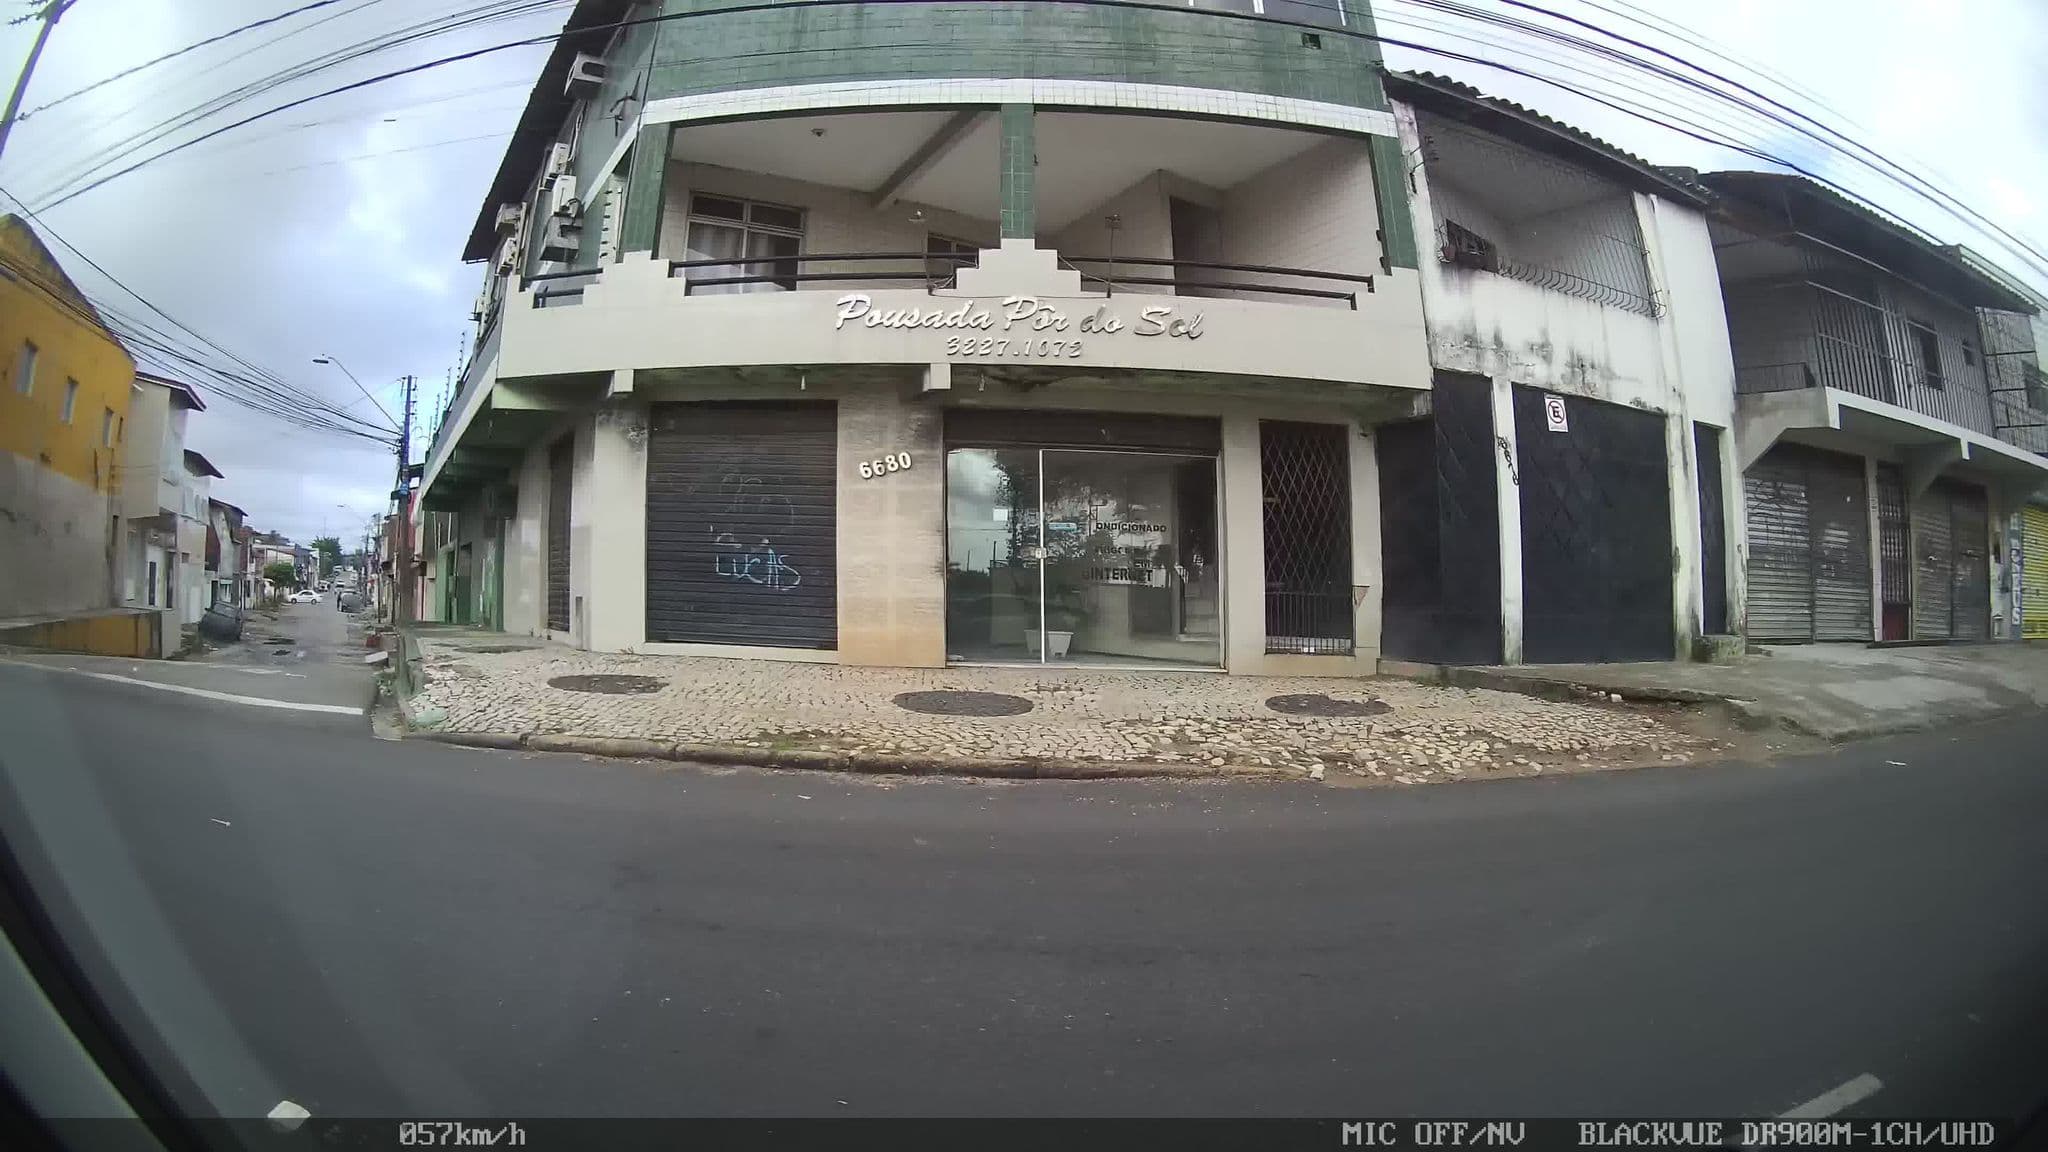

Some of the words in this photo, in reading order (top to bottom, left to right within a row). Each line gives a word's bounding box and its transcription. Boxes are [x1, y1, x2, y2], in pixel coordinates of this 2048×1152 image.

[834, 294, 994, 331] Pousada
[1080, 304, 1124, 333] do
[1134, 305, 1204, 340] Sol
[946, 336, 1082, 358] 3227.1072
[859, 452, 912, 479] 6680
[715, 548, 801, 591] LUCAS
